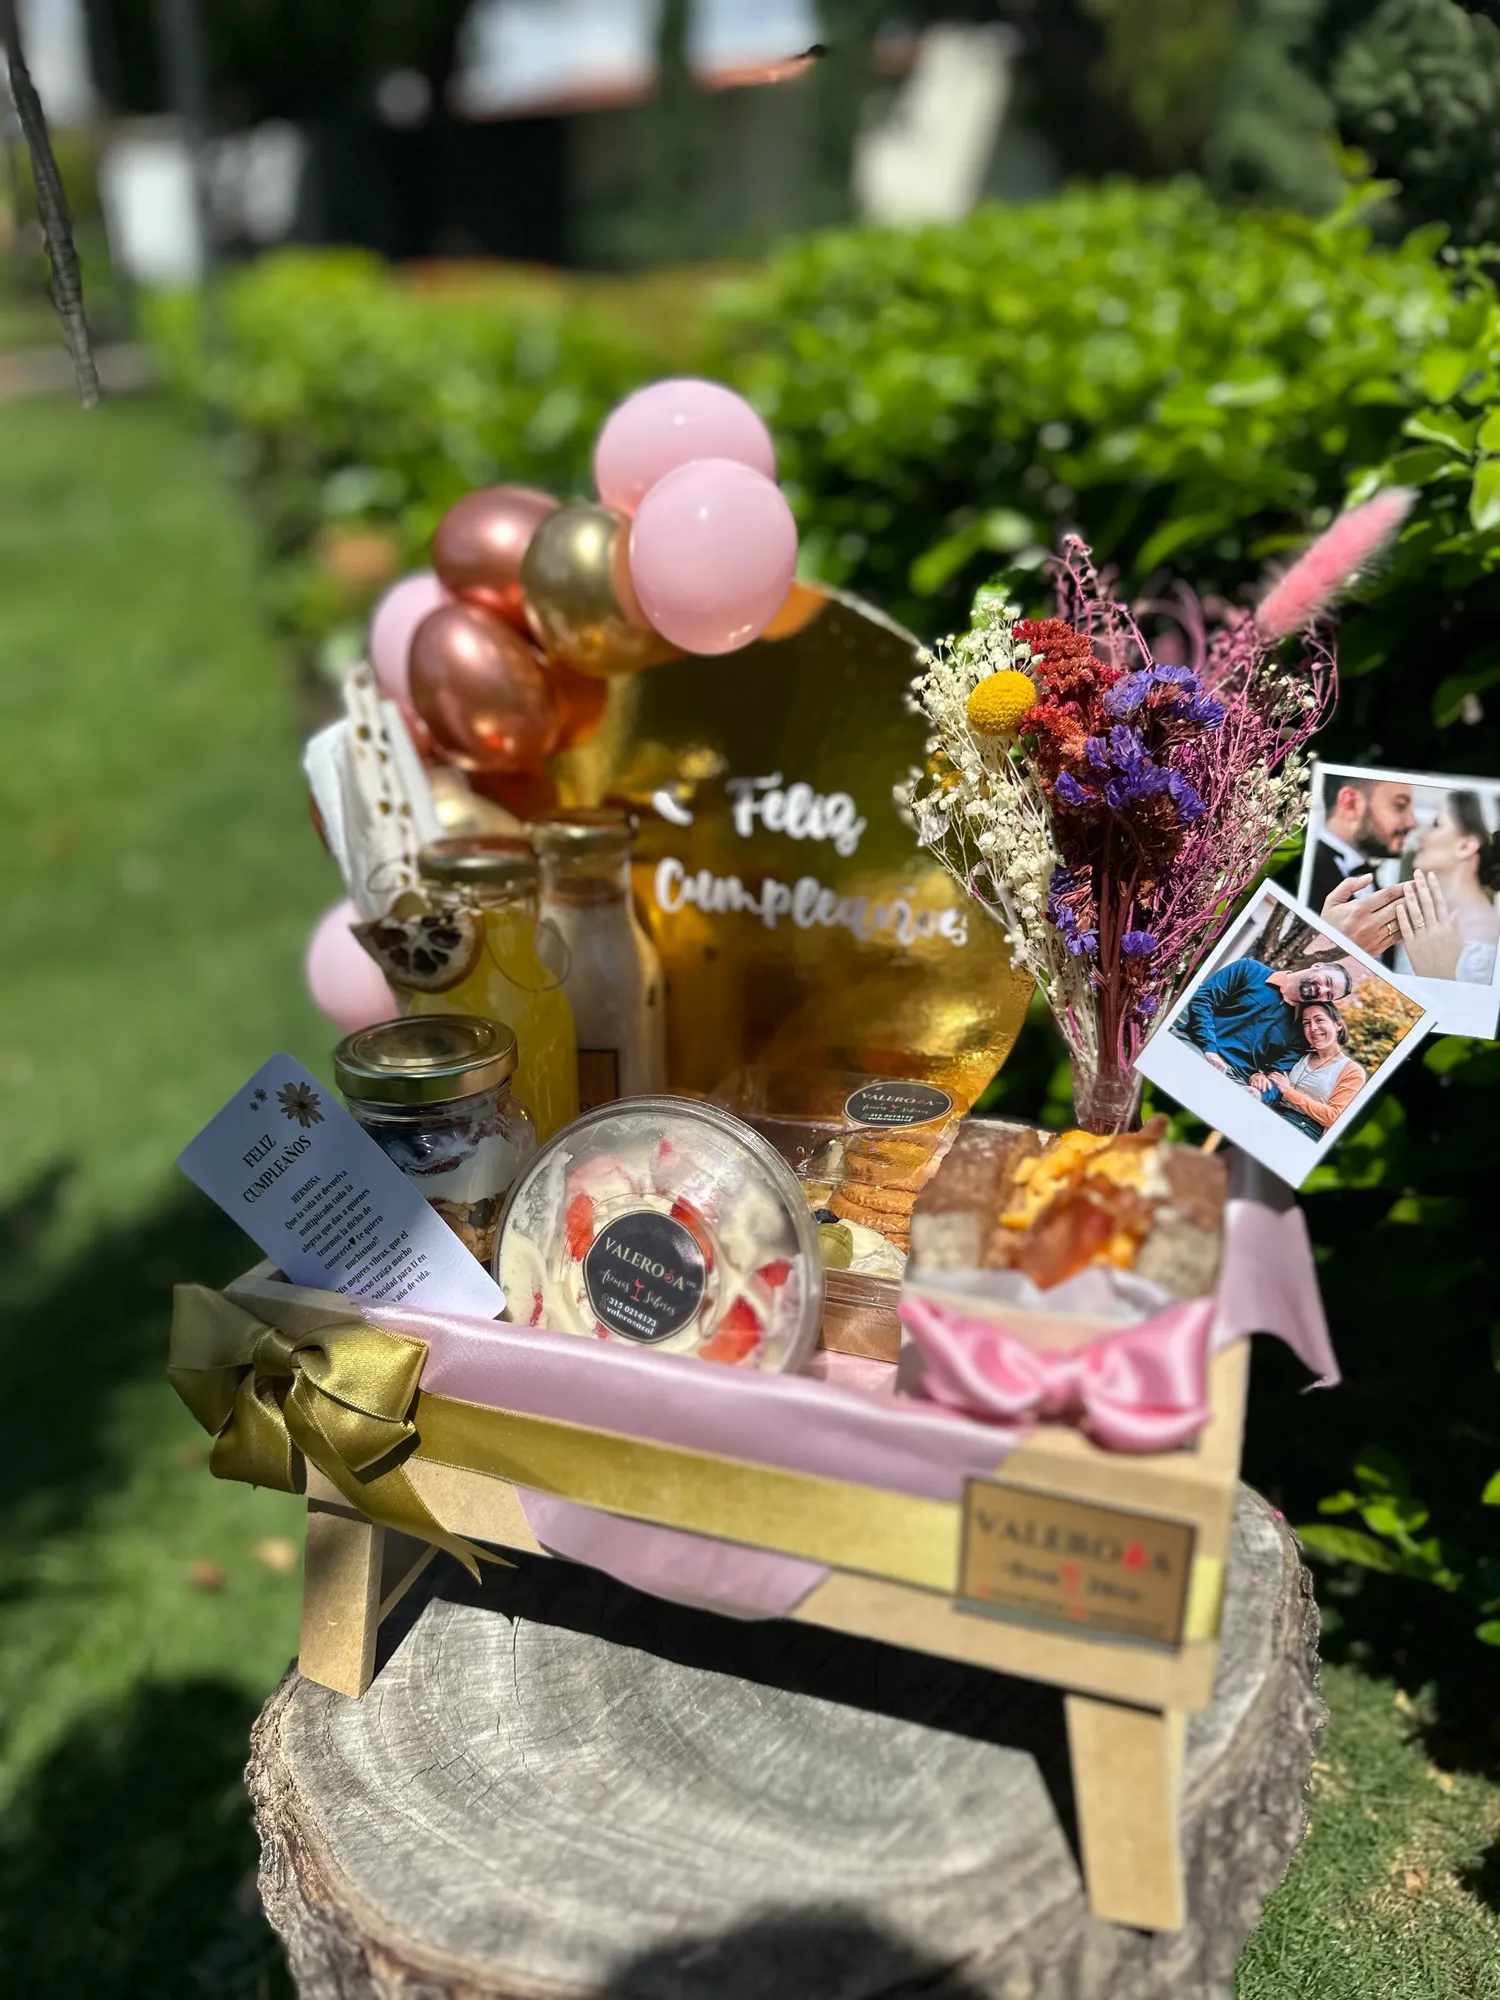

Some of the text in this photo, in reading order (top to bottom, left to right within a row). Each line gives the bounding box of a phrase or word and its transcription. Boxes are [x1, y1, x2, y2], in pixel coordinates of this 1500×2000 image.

[726, 771, 867, 857] Feliz
[242, 1134, 277, 1168] FELIZ
[243, 1134, 312, 1203] CUMPLEAÑOS
[284, 1169, 348, 1230] Que la vida te devuelva
[290, 1174, 321, 1204] HERMOSA
[299, 1184, 354, 1237] multiplicado toda la
[321, 1223, 332, 1236] que
[332, 1213, 344, 1225] das
[346, 1188, 371, 1212] quienes
[317, 1206, 373, 1257] tenemos la dicha de
[324, 1215, 384, 1270] conocerte te quiero
[347, 1264, 371, 1283] mejores
[389, 1238, 402, 1251] que
[400, 1230, 409, 1240] el
[373, 1264, 393, 1282] traiga
[392, 1246, 413, 1267] mucho
[397, 1267, 413, 1283] para
[411, 1260, 419, 1269] ti
[418, 1253, 427, 1263] en
[407, 1281, 416, 1291] de
[415, 1270, 431, 1284] vida.
[604, 1237, 685, 1291] VALEROSA
[606, 1305, 655, 1336] valerosacol
[608, 1296, 657, 1327] 315 0214173
